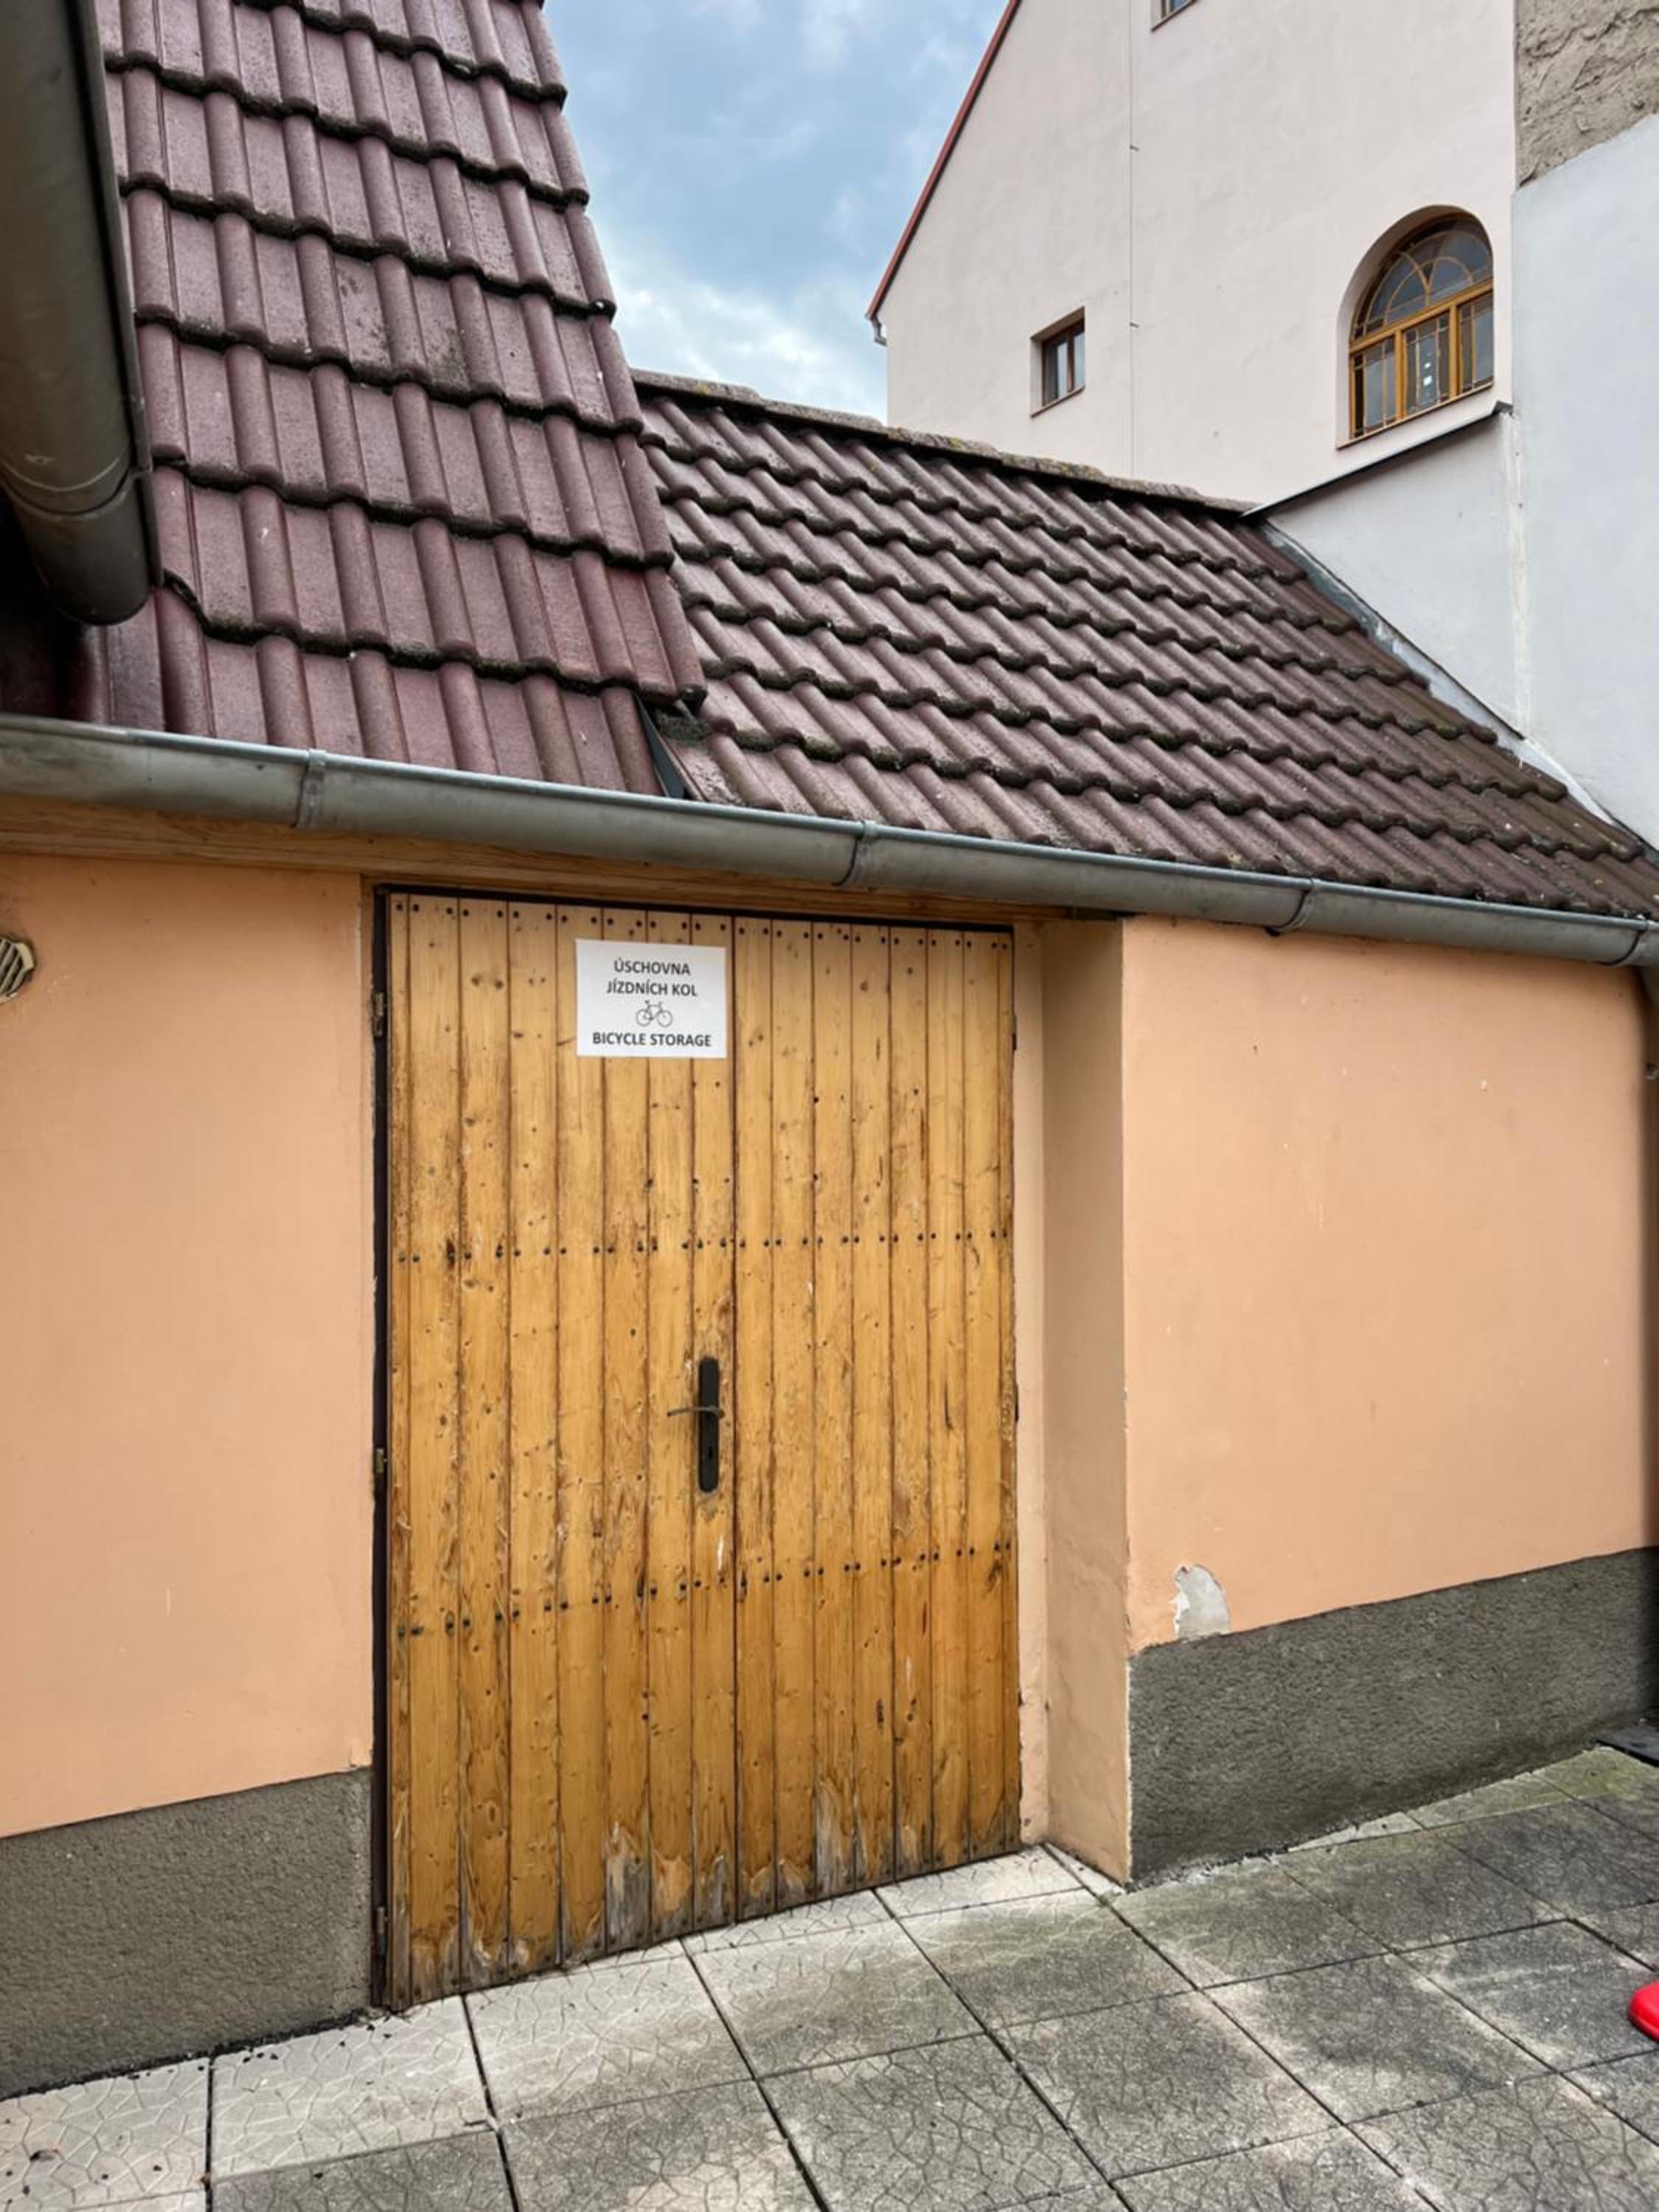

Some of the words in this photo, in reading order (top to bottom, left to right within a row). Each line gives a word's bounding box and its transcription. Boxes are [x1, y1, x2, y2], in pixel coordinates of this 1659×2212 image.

[613, 958, 691, 975] ÚSCHOVNA
[606, 979, 667, 995] JÍZDNÍCH
[672, 984, 698, 997] KOL
[592, 1032, 647, 1046] BICYCLE
[650, 1034, 712, 1047] STORAGE
